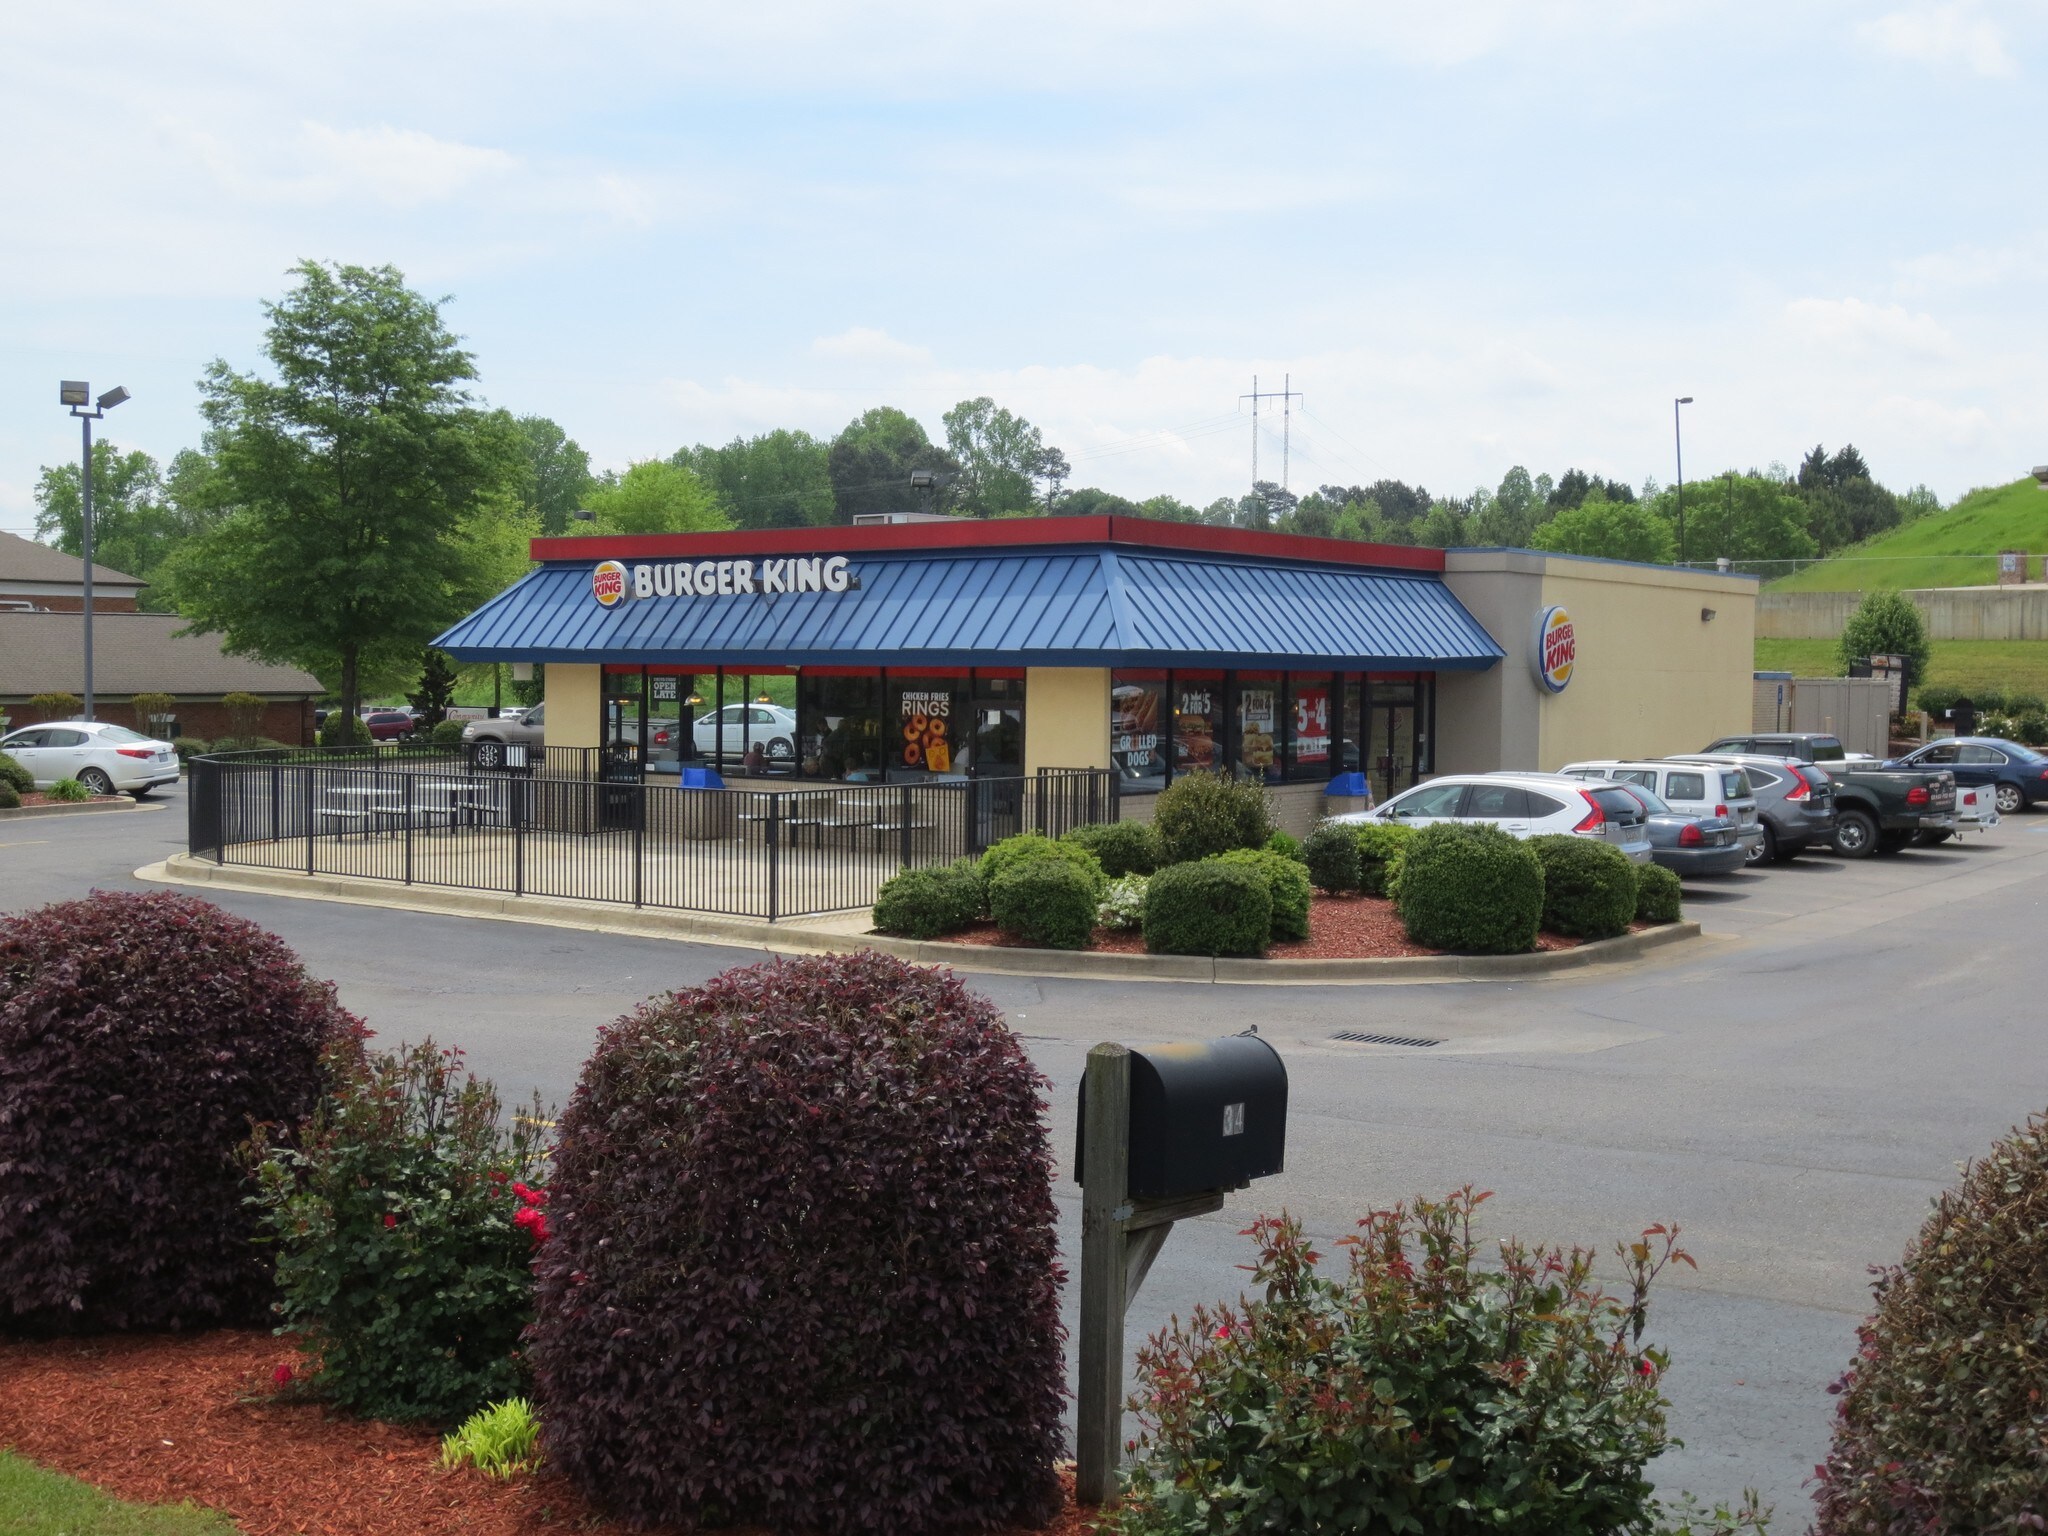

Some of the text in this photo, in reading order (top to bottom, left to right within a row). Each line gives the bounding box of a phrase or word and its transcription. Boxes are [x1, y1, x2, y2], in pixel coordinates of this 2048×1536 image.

[594, 572, 620, 584] BURGER
[634, 556, 849, 597] BURGER KING
[594, 581, 621, 597] KING
[1546, 639, 1575, 672] KING
[654, 682, 676, 690] OPEN
[654, 691, 676, 699] LATE
[902, 691, 949, 701] CHICKEN FRIES
[1182, 693, 1189, 714] 2
[1190, 701, 1202, 714] FOR
[1245, 694, 1252, 713] 2
[1253, 698, 1264, 710] FOR
[902, 700, 949, 717] RINGS
[1297, 698, 1308, 732] 5
[1127, 750, 1149, 766] DOGS
[1224, 1103, 1244, 1135] 34
